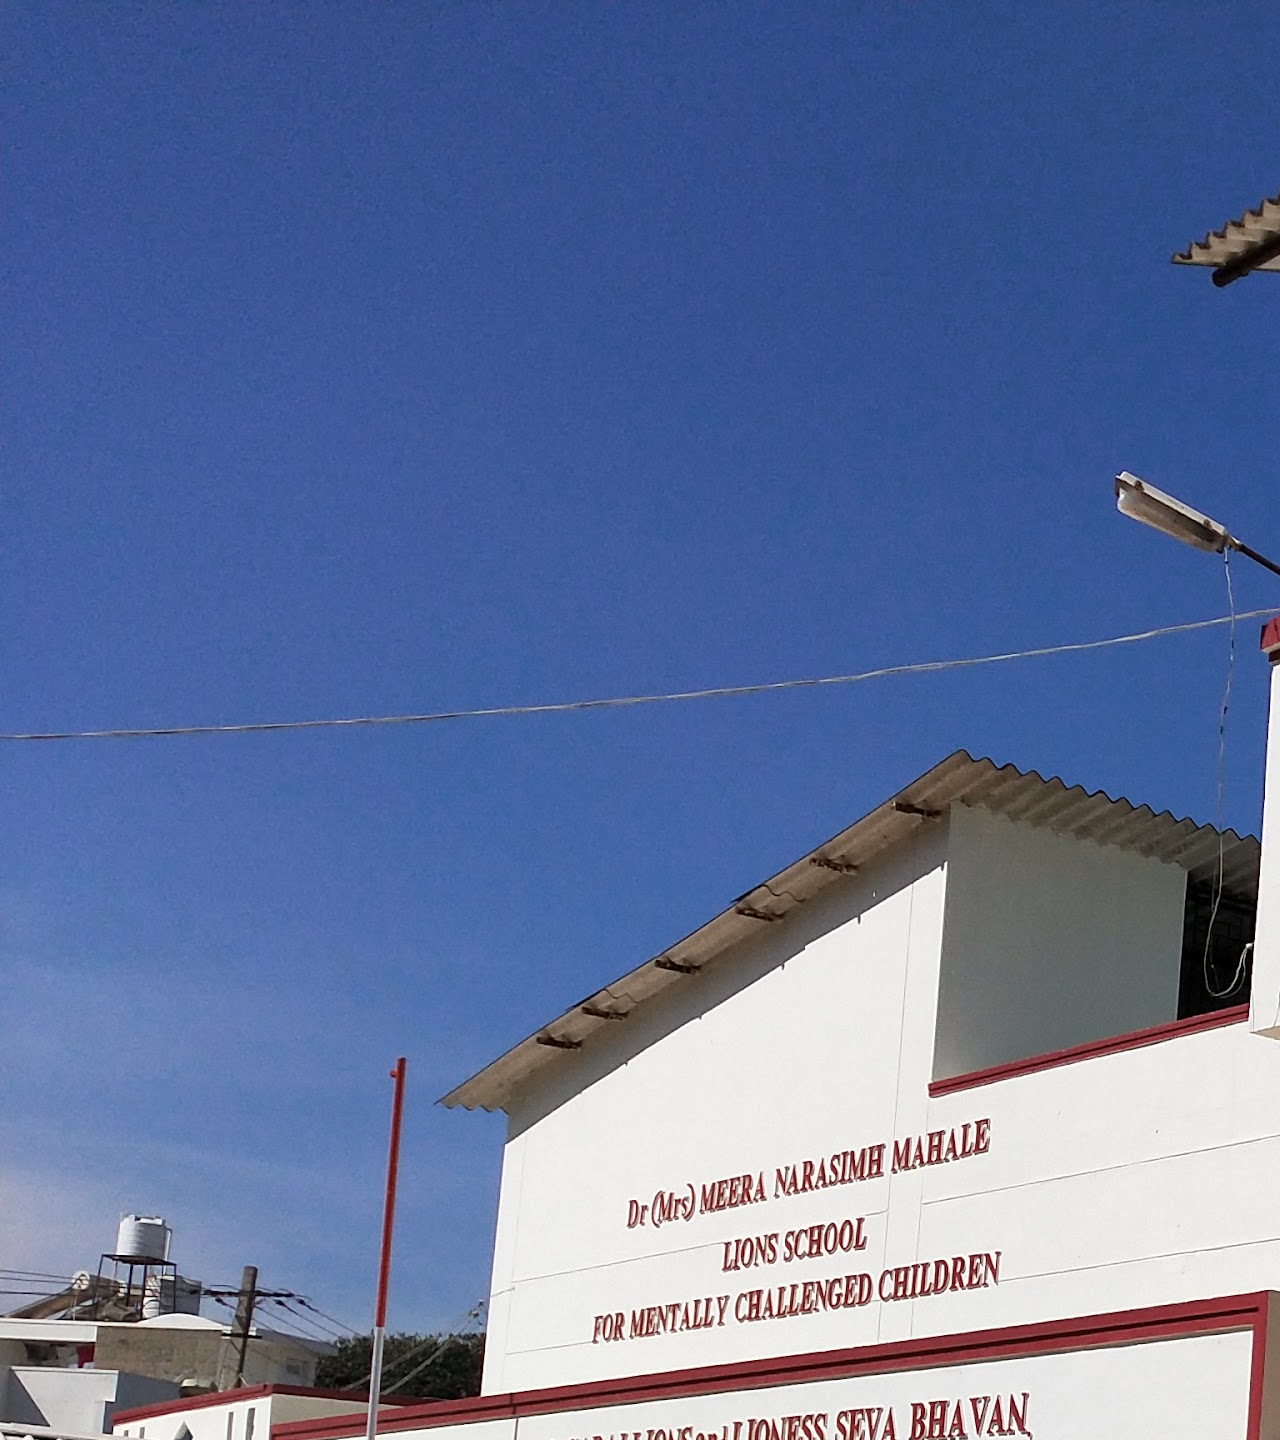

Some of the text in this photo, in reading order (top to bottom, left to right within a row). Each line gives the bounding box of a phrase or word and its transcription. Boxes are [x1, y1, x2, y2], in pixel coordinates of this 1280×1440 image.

[626, 1118, 992, 1229] Dr (Mrs) MEERA NARASIMH MAHALE
[722, 1217, 868, 1272] LIONS SCHOOL
[591, 1251, 1002, 1344] FOR MENTALLY CHALLENGED CHILDREN
